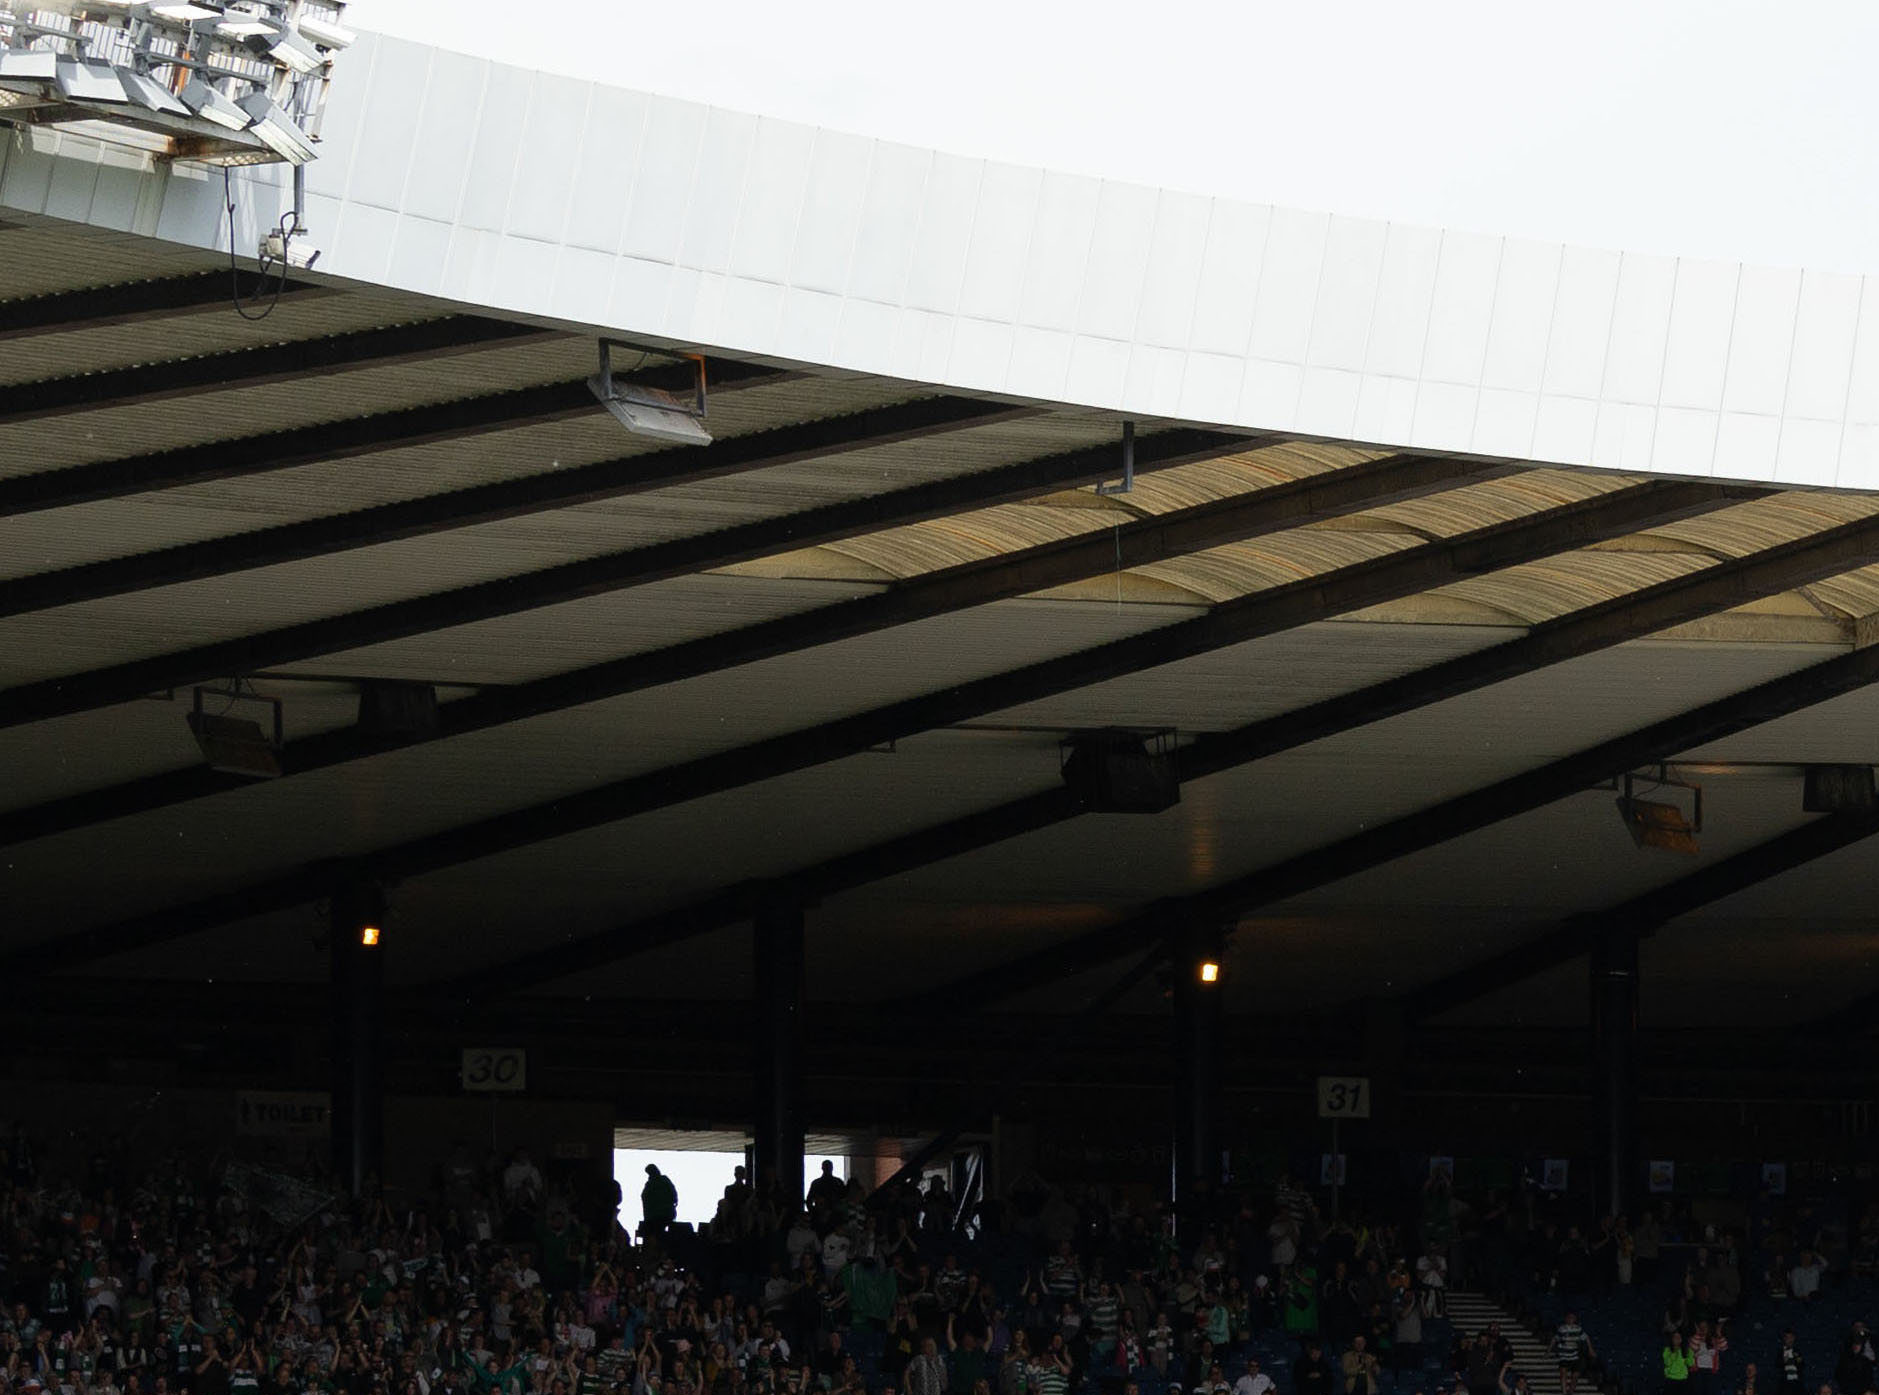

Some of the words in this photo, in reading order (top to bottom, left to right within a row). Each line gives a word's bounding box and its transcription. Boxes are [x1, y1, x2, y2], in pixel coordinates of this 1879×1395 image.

[469, 1055, 518, 1083] 30
[1327, 1082, 1361, 1113] 31
[254, 1103, 326, 1122] TOILET
